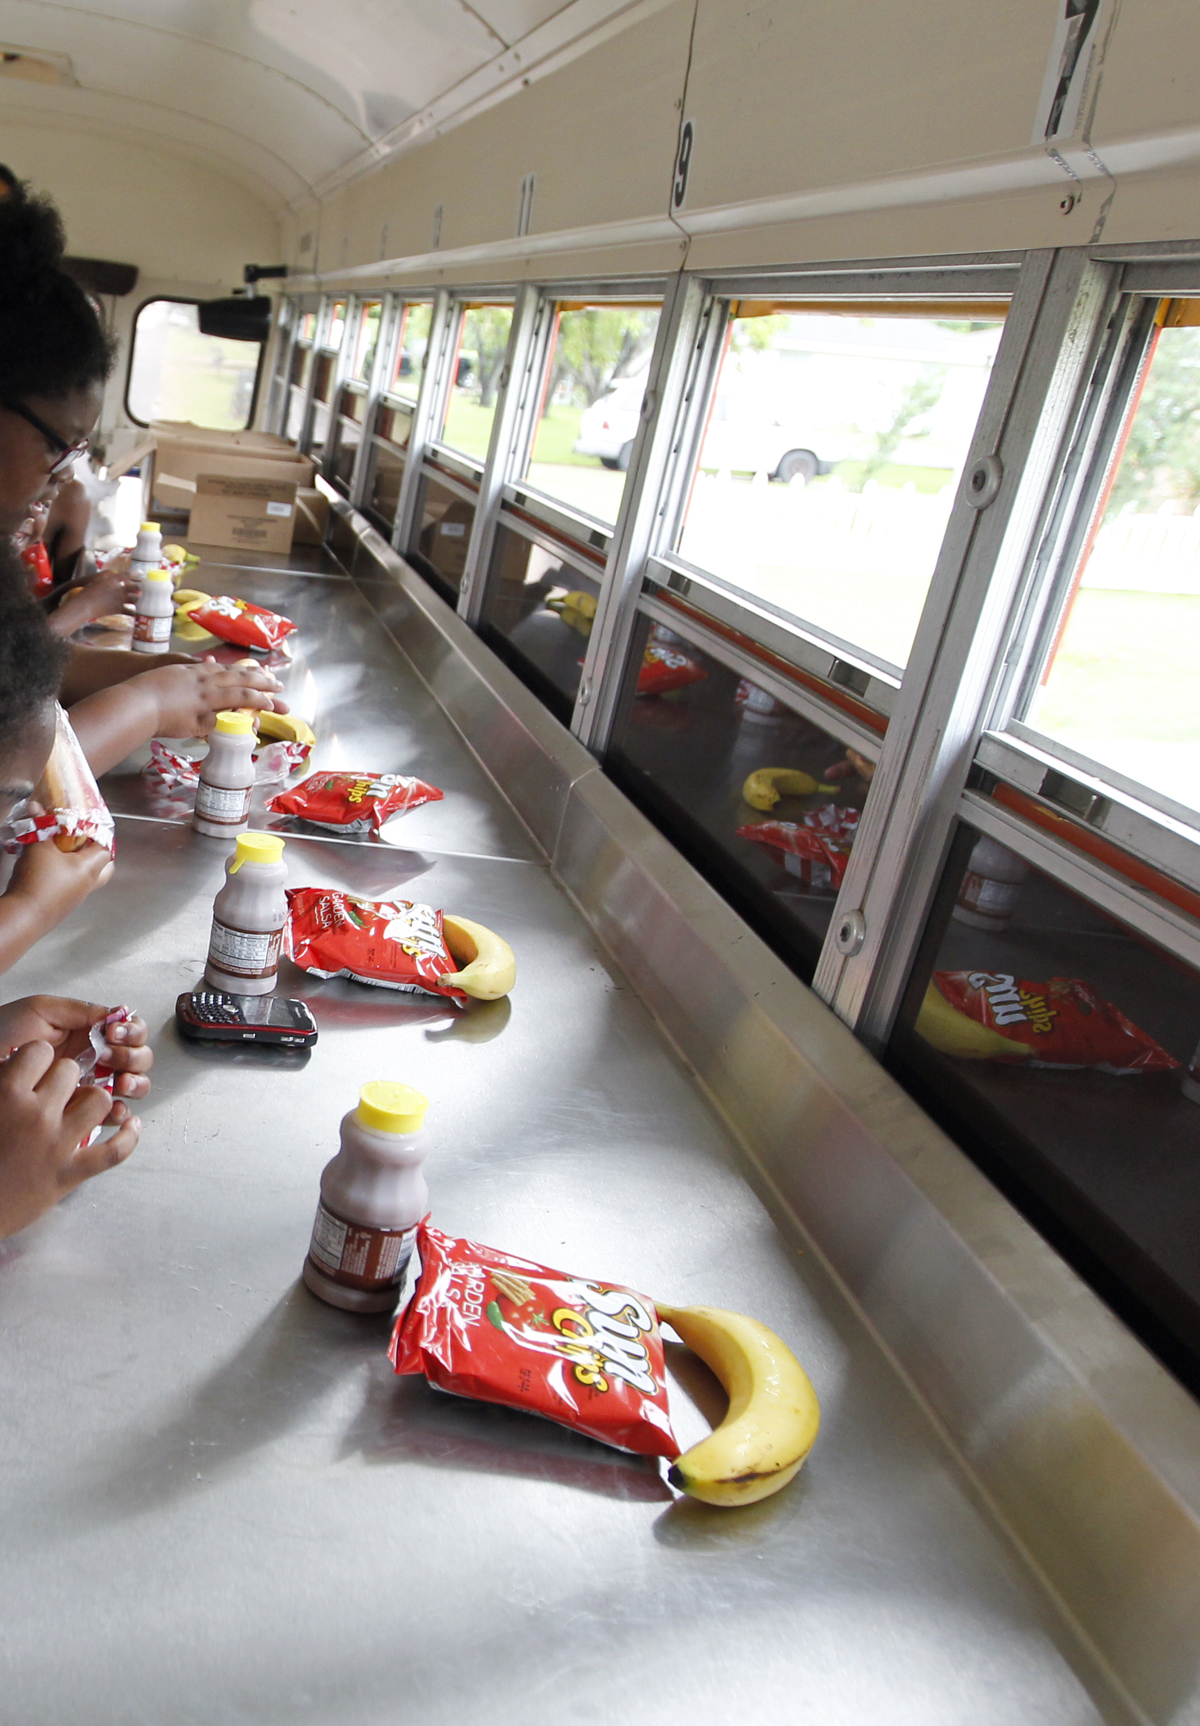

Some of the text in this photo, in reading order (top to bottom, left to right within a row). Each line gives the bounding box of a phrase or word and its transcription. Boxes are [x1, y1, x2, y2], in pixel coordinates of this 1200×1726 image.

[674, 121, 694, 208] 9
[347, 779, 374, 804] hips
[319, 895, 333, 929] SALSA
[566, 1277, 659, 1395] Sun
